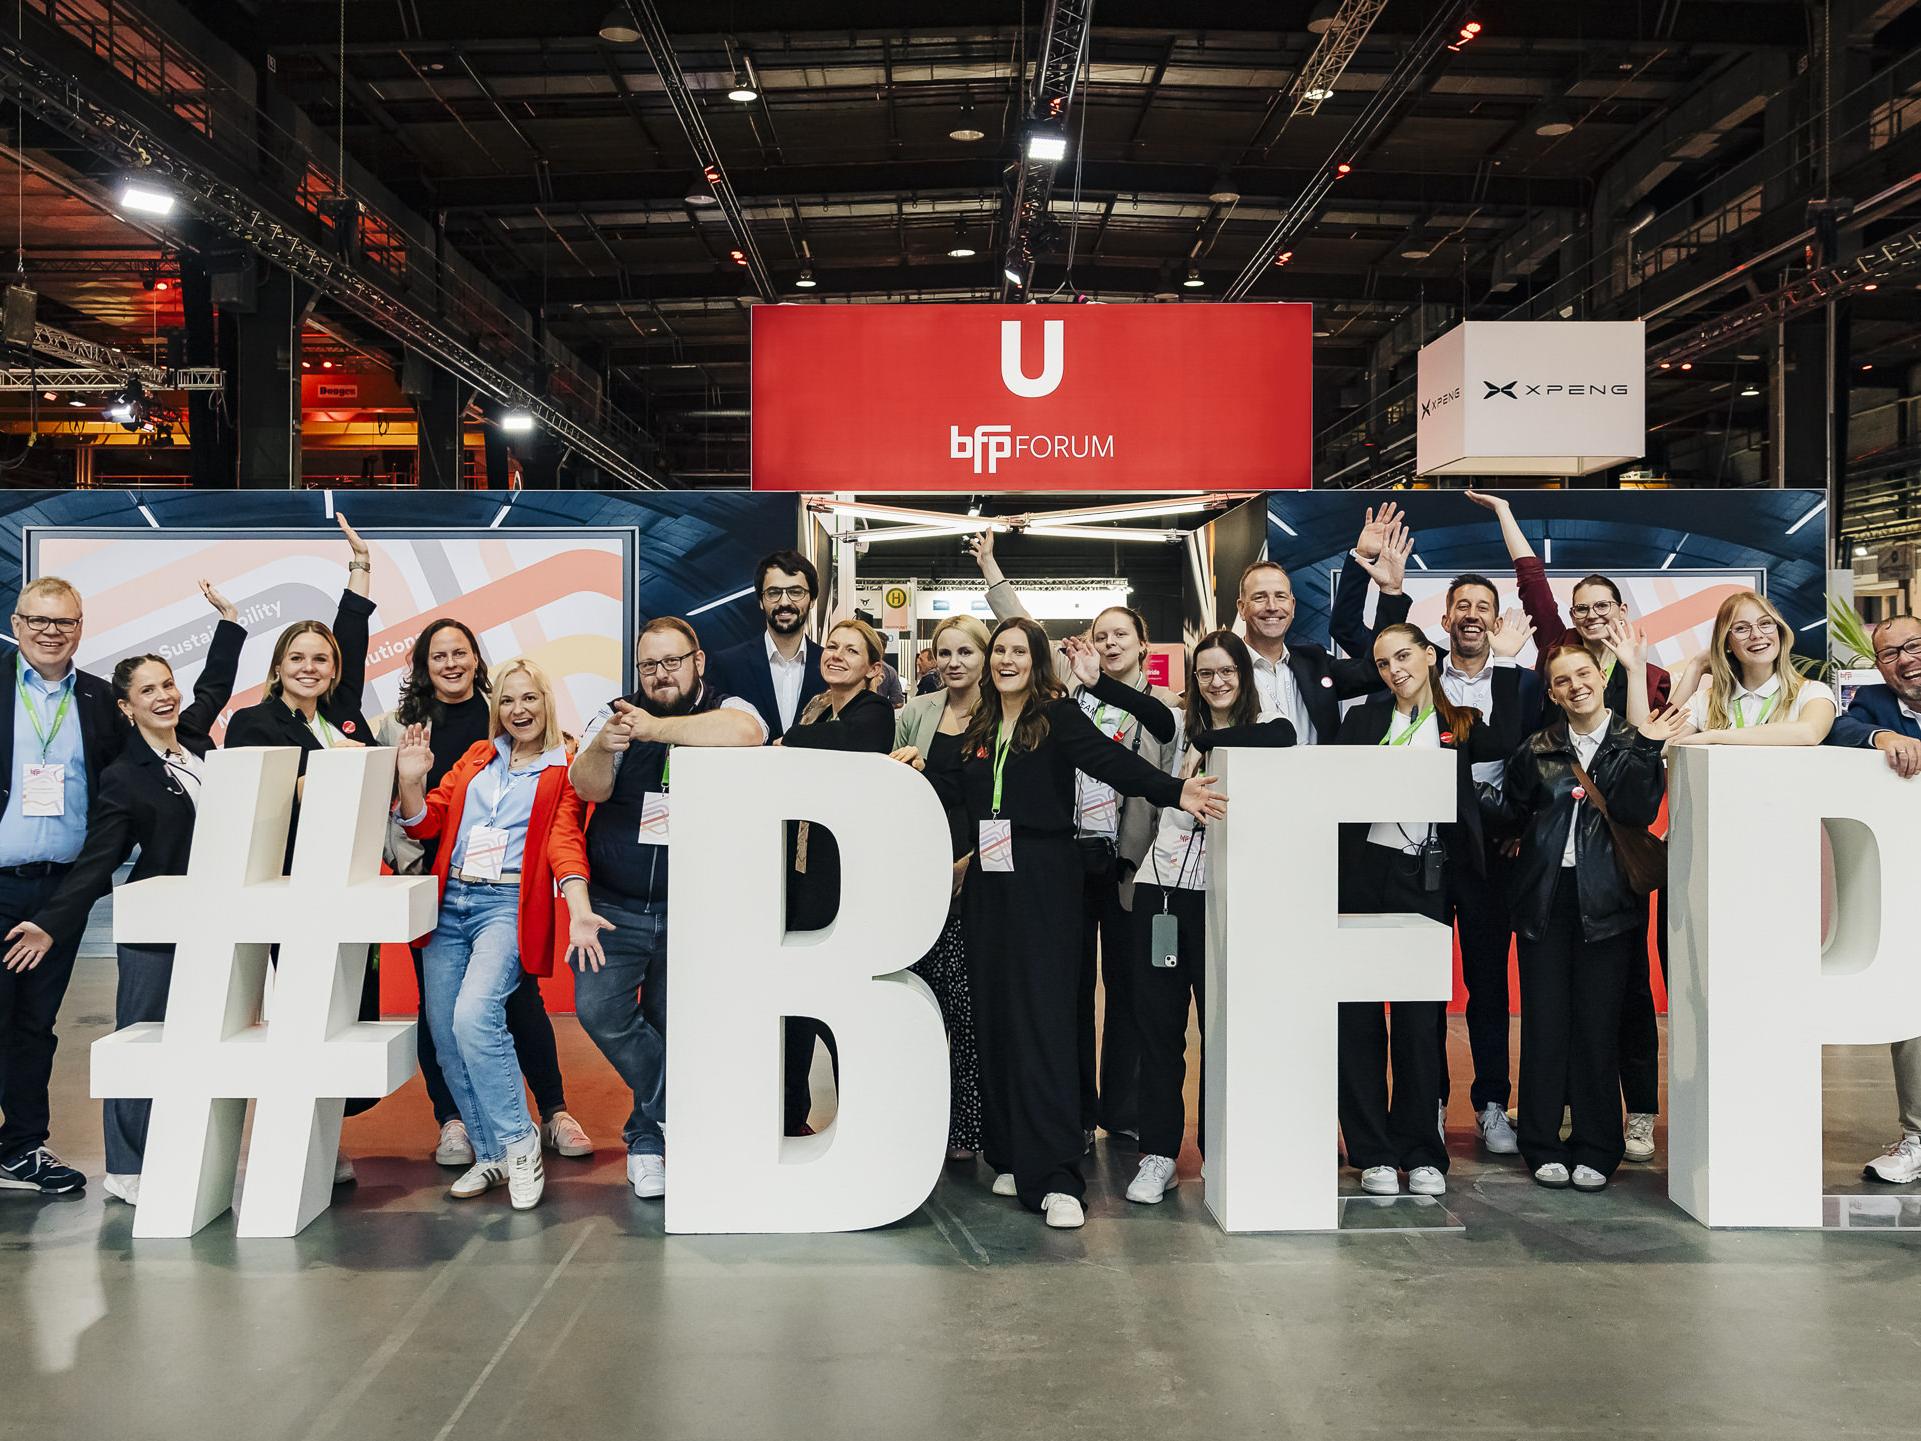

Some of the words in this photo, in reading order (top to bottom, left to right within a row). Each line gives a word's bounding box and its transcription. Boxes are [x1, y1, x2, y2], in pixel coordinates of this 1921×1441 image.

[1001, 320, 1064, 398] U
[1432, 387, 1460, 410] XPENG
[1525, 384, 1628, 396] XPENG
[950, 425, 1012, 474] bfp
[1016, 434, 1114, 458] FORUM
[158, 600, 282, 660] Sustaibility
